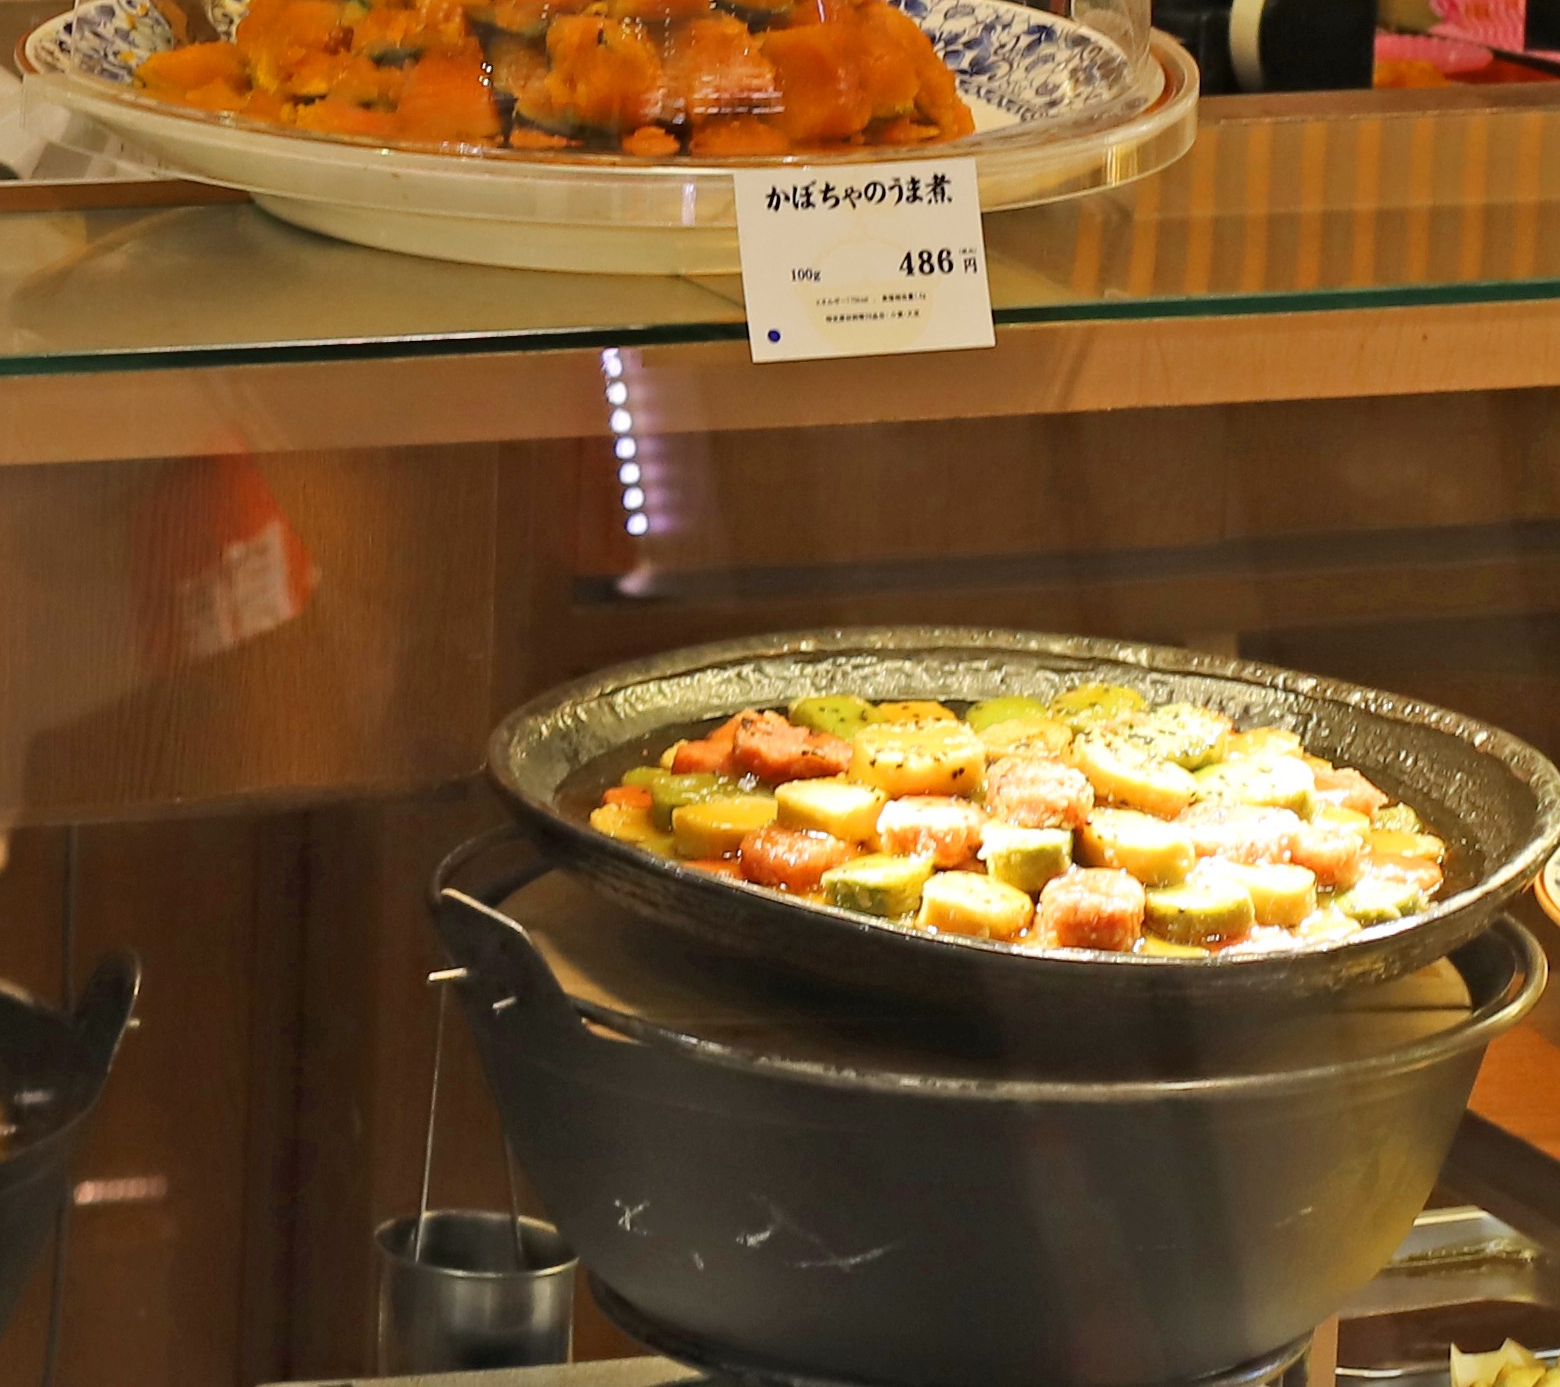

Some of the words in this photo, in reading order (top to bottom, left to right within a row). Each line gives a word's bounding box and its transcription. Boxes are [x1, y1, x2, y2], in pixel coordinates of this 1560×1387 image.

[766, 171, 954, 212] かぼちゃのうま煮
[791, 268, 822, 282] 100g
[899, 248, 955, 277] 486
